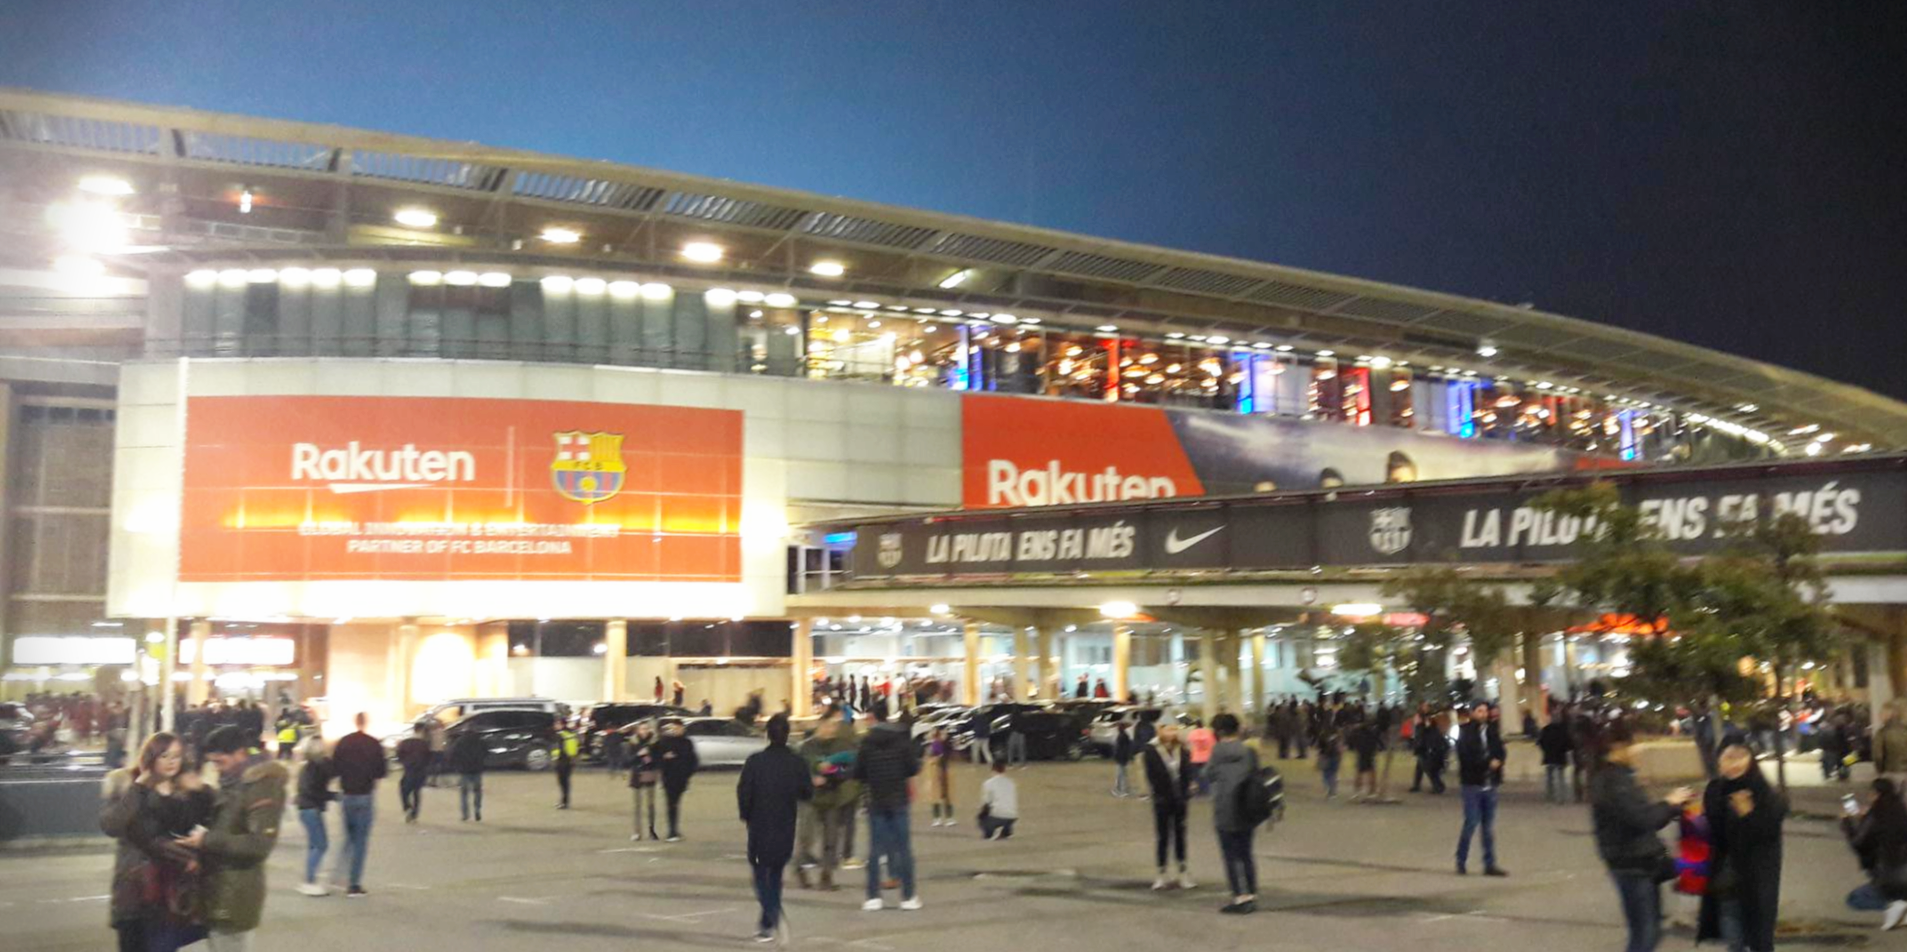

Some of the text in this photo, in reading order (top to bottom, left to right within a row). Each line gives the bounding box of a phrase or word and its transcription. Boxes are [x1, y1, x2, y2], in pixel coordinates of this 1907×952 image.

[291, 440, 475, 481] Rakuten
[987, 459, 1176, 507] Rakuten
[298, 521, 362, 536] GLOBAL
[364, 522, 467, 536] INNOVATION
[484, 523, 620, 538] ENTERTAINMENT
[925, 520, 1136, 563] LA PILOTA ENS FA MÉS
[1460, 508, 1501, 548] LA
[1635, 496, 1710, 540] ENS
[347, 539, 572, 554] PARTNER OF FC BARCELONA
